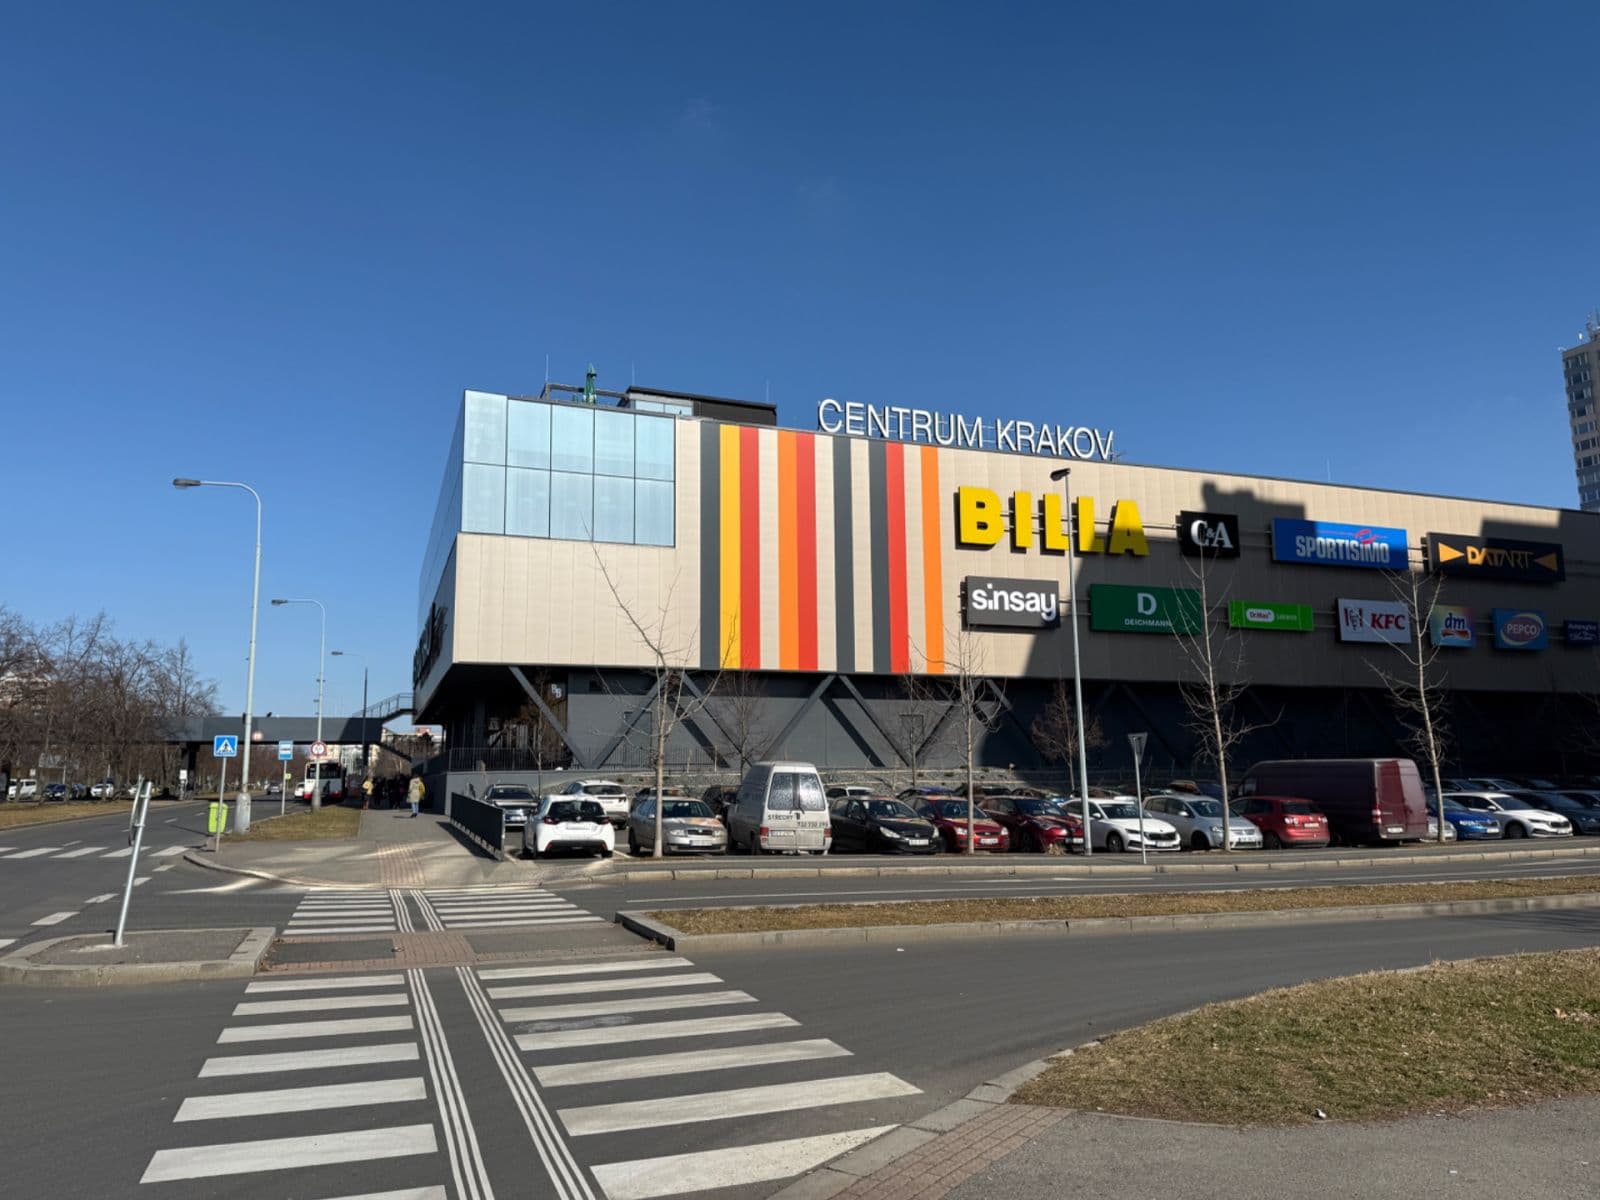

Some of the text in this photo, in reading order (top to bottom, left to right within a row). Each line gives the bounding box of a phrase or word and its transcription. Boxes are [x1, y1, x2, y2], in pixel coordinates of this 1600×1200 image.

[819, 399, 1113, 460] CENTRUM KRAKOV
[958, 486, 1149, 556] BILLA
[1190, 519, 1234, 549] C&A
[1295, 535, 1390, 564] SPORTISIMO
[1466, 545, 1533, 569] DATART
[971, 584, 1056, 620] sinsay
[1137, 592, 1157, 616] D
[1124, 618, 1172, 628] DEICHMANN
[1371, 612, 1406, 630] KFC
[1444, 612, 1466, 631] dm
[1506, 623, 1538, 636] PEPCO
